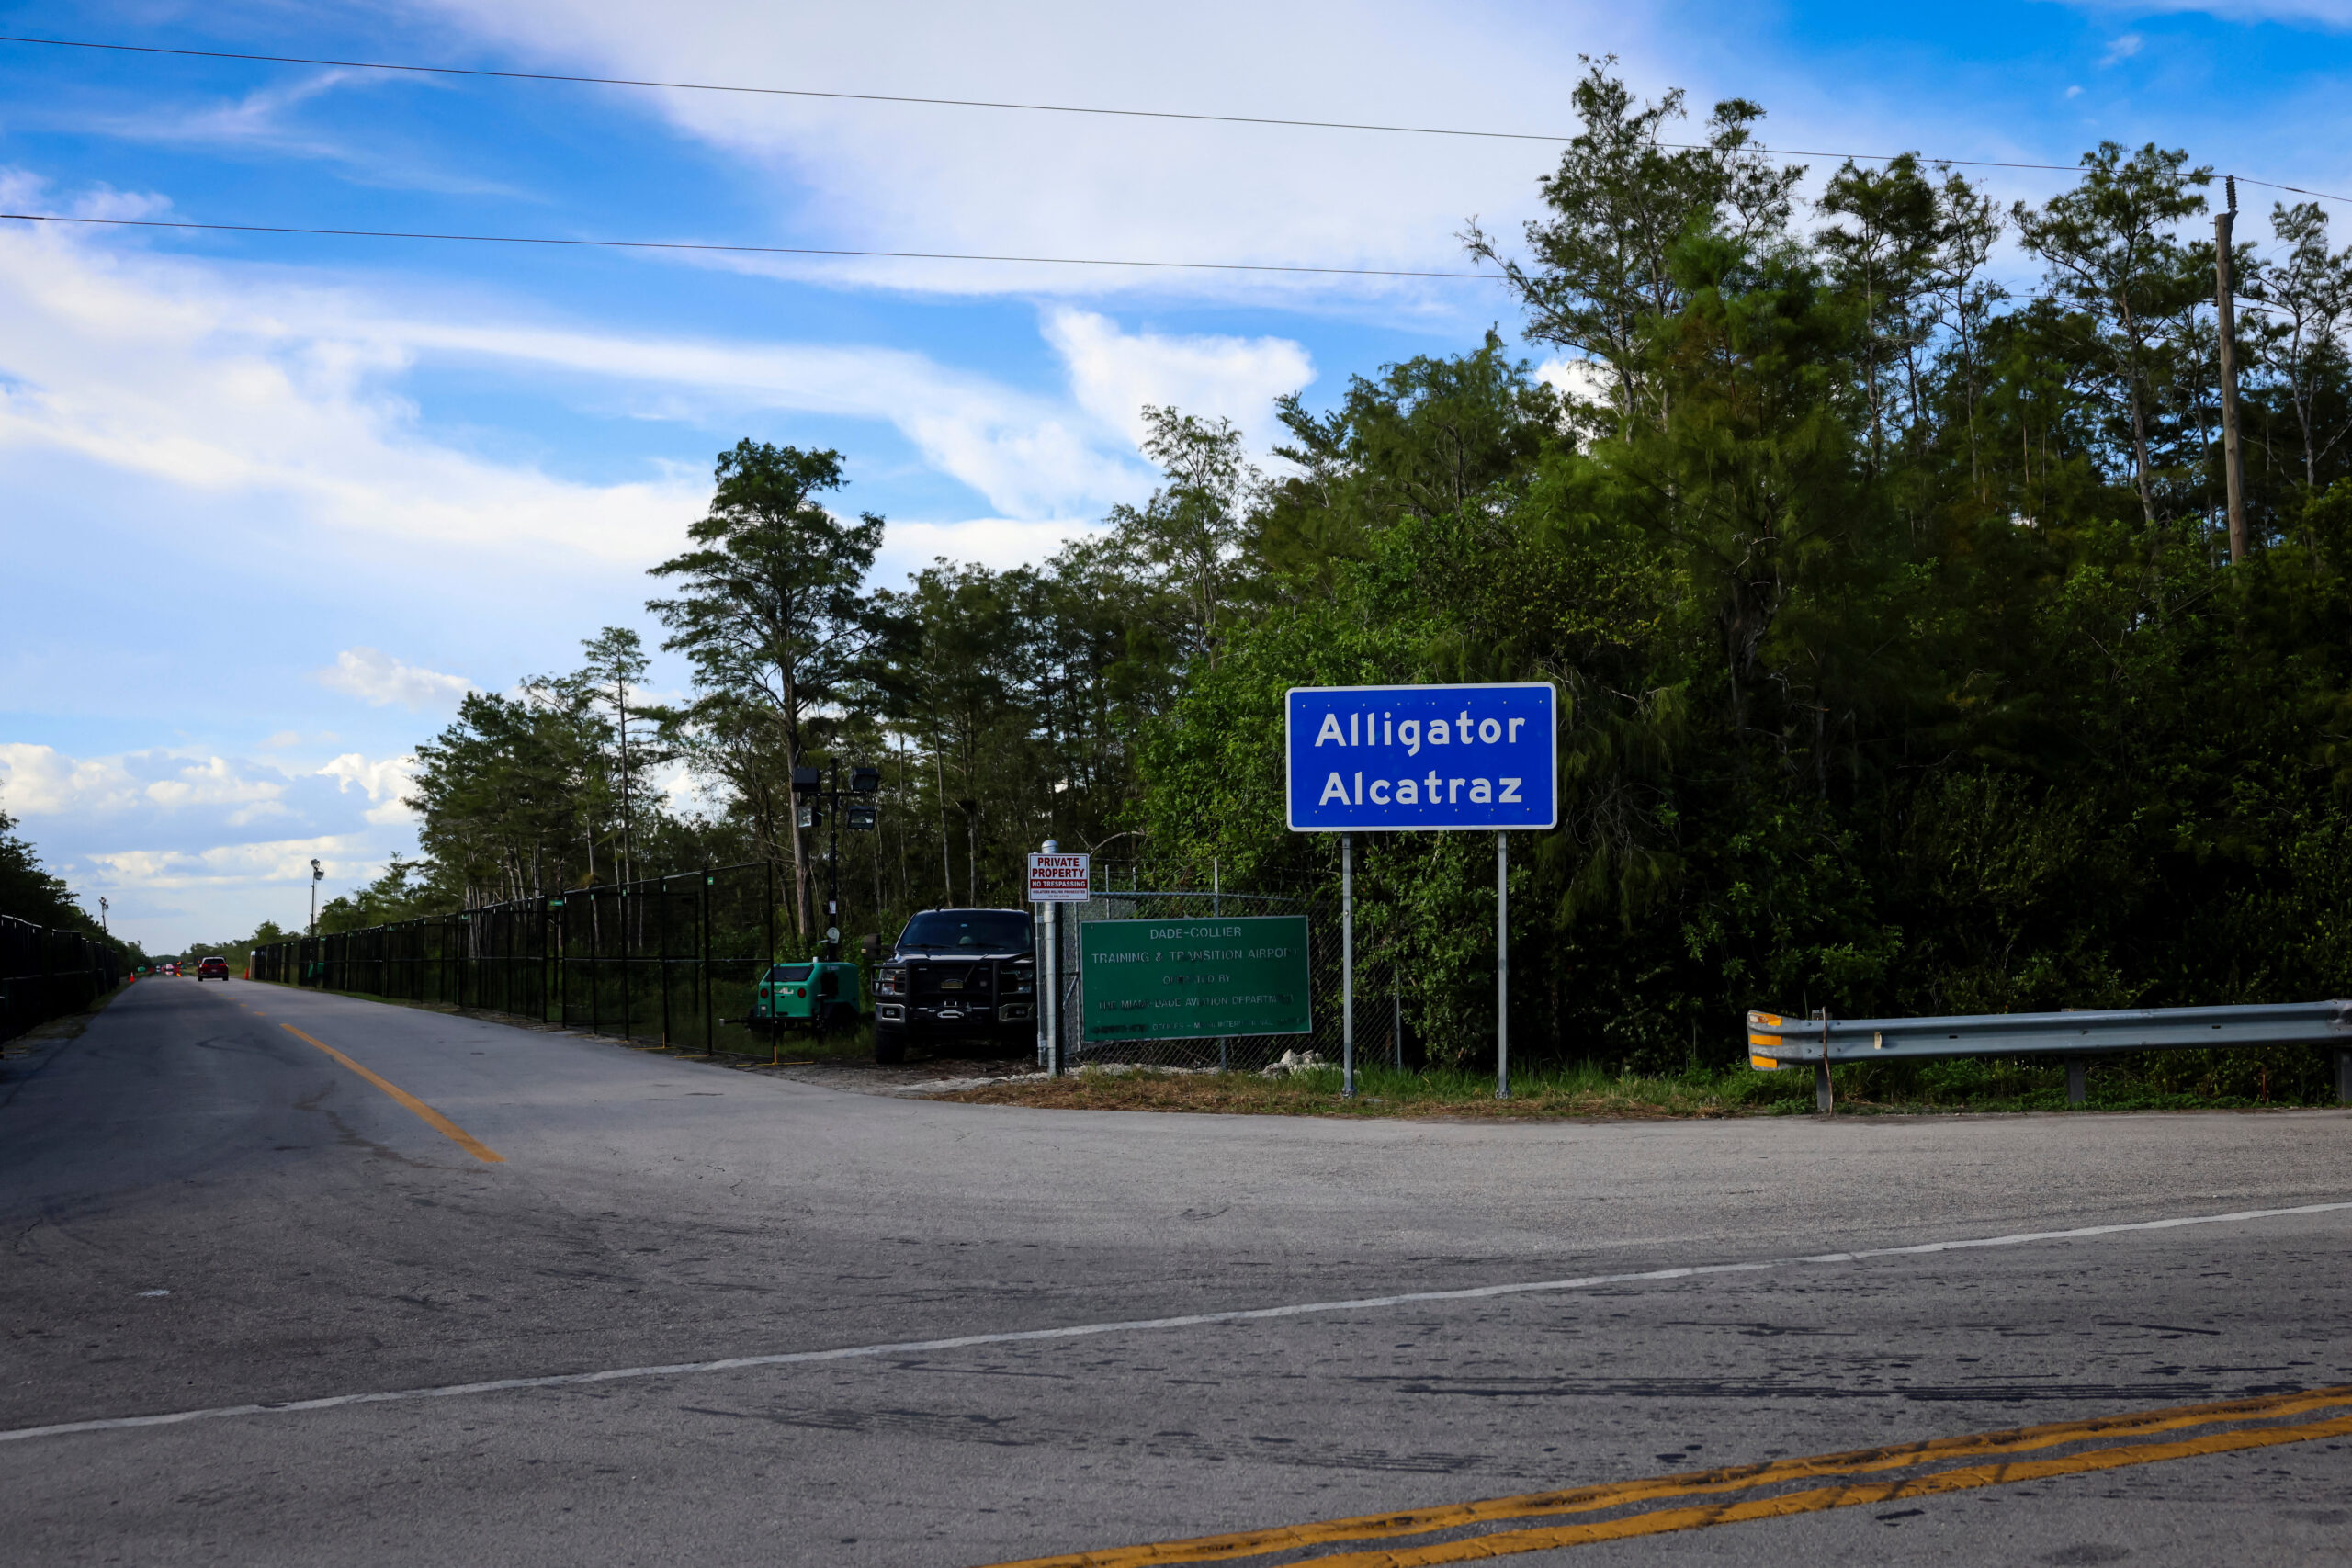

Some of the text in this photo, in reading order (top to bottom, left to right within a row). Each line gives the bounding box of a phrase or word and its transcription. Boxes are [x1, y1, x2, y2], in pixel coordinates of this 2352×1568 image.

[1314, 710, 1526, 757] Alligator
[1318, 770, 1522, 806] Alcatraz
[1037, 857, 1080, 867] PRIVATE
[1032, 868, 1085, 878] PROPERTY
[1150, 926, 1241, 939] DADE-COLLIER
[1091, 952, 1150, 964] TRAINING
[1155, 951, 1163, 962] &
[1218, 974, 1230, 983] BY
[1232, 994, 1294, 1005] DEPARTM
